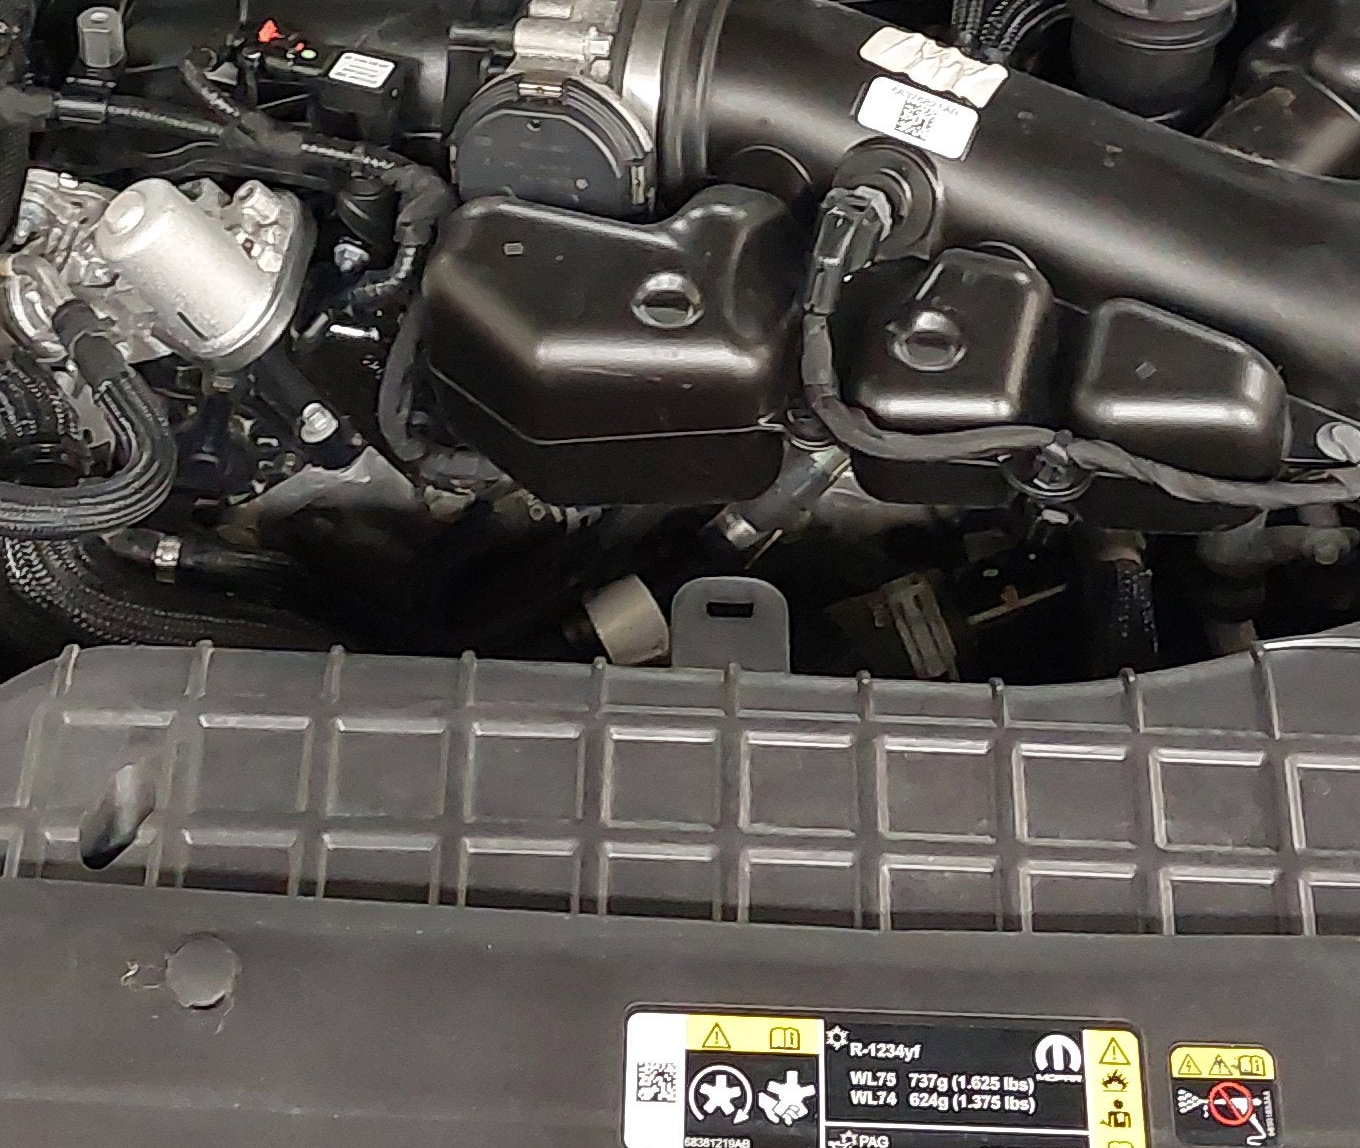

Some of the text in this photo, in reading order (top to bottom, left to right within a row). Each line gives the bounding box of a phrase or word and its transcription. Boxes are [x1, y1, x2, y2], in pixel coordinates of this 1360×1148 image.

[849, 1043, 922, 1063] R-1234yf
[849, 1071, 1035, 1095] WL75 737g (1.625 lbs)
[849, 1090, 1037, 1115] WL74 624g (1.375 lbs)
[859, 1135, 890, 1148] PAG
